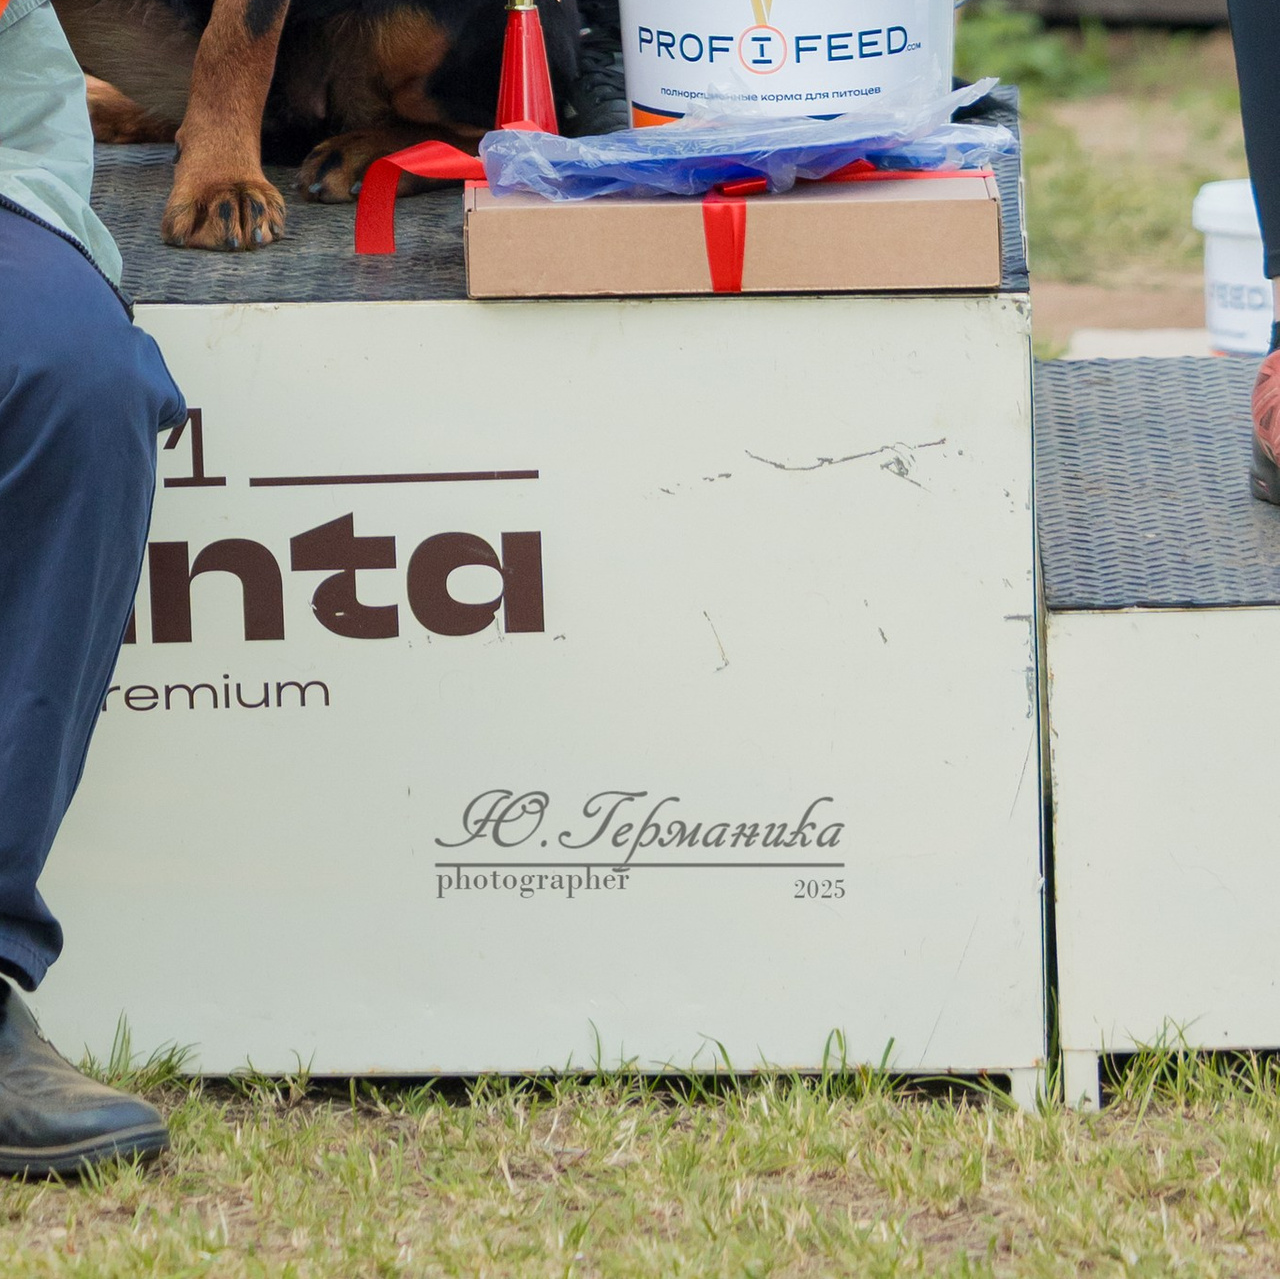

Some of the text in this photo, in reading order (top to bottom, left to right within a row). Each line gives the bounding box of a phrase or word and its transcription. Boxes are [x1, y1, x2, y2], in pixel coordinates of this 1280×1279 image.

[761, 93, 802, 102] корма
[805, 91, 829, 101] для
[163, 407, 227, 488] 1
